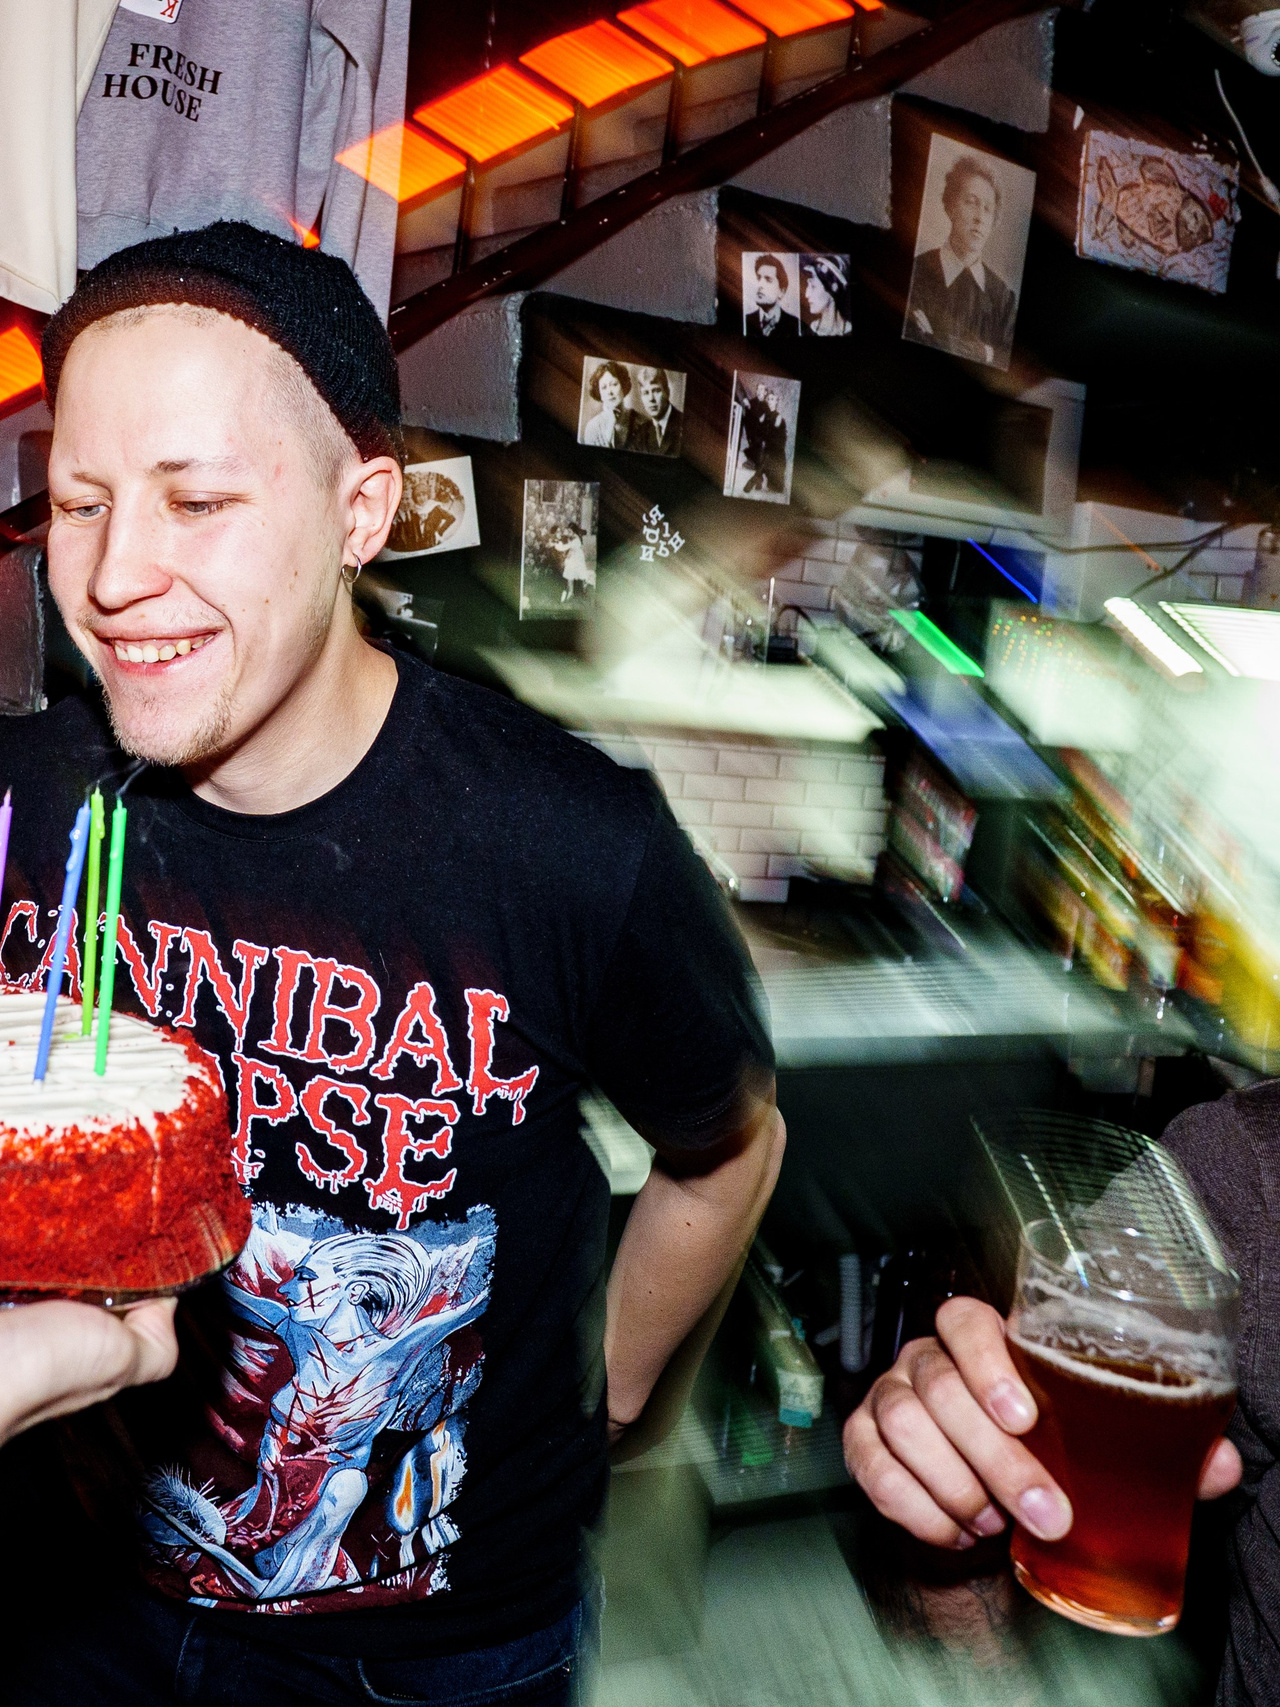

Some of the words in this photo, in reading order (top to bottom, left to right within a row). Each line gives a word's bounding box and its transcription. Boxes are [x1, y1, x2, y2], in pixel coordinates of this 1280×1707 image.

[127, 42, 223, 95] FRESH
[102, 73, 202, 122] HOUSE
[199, 1046, 458, 1230] PSE
